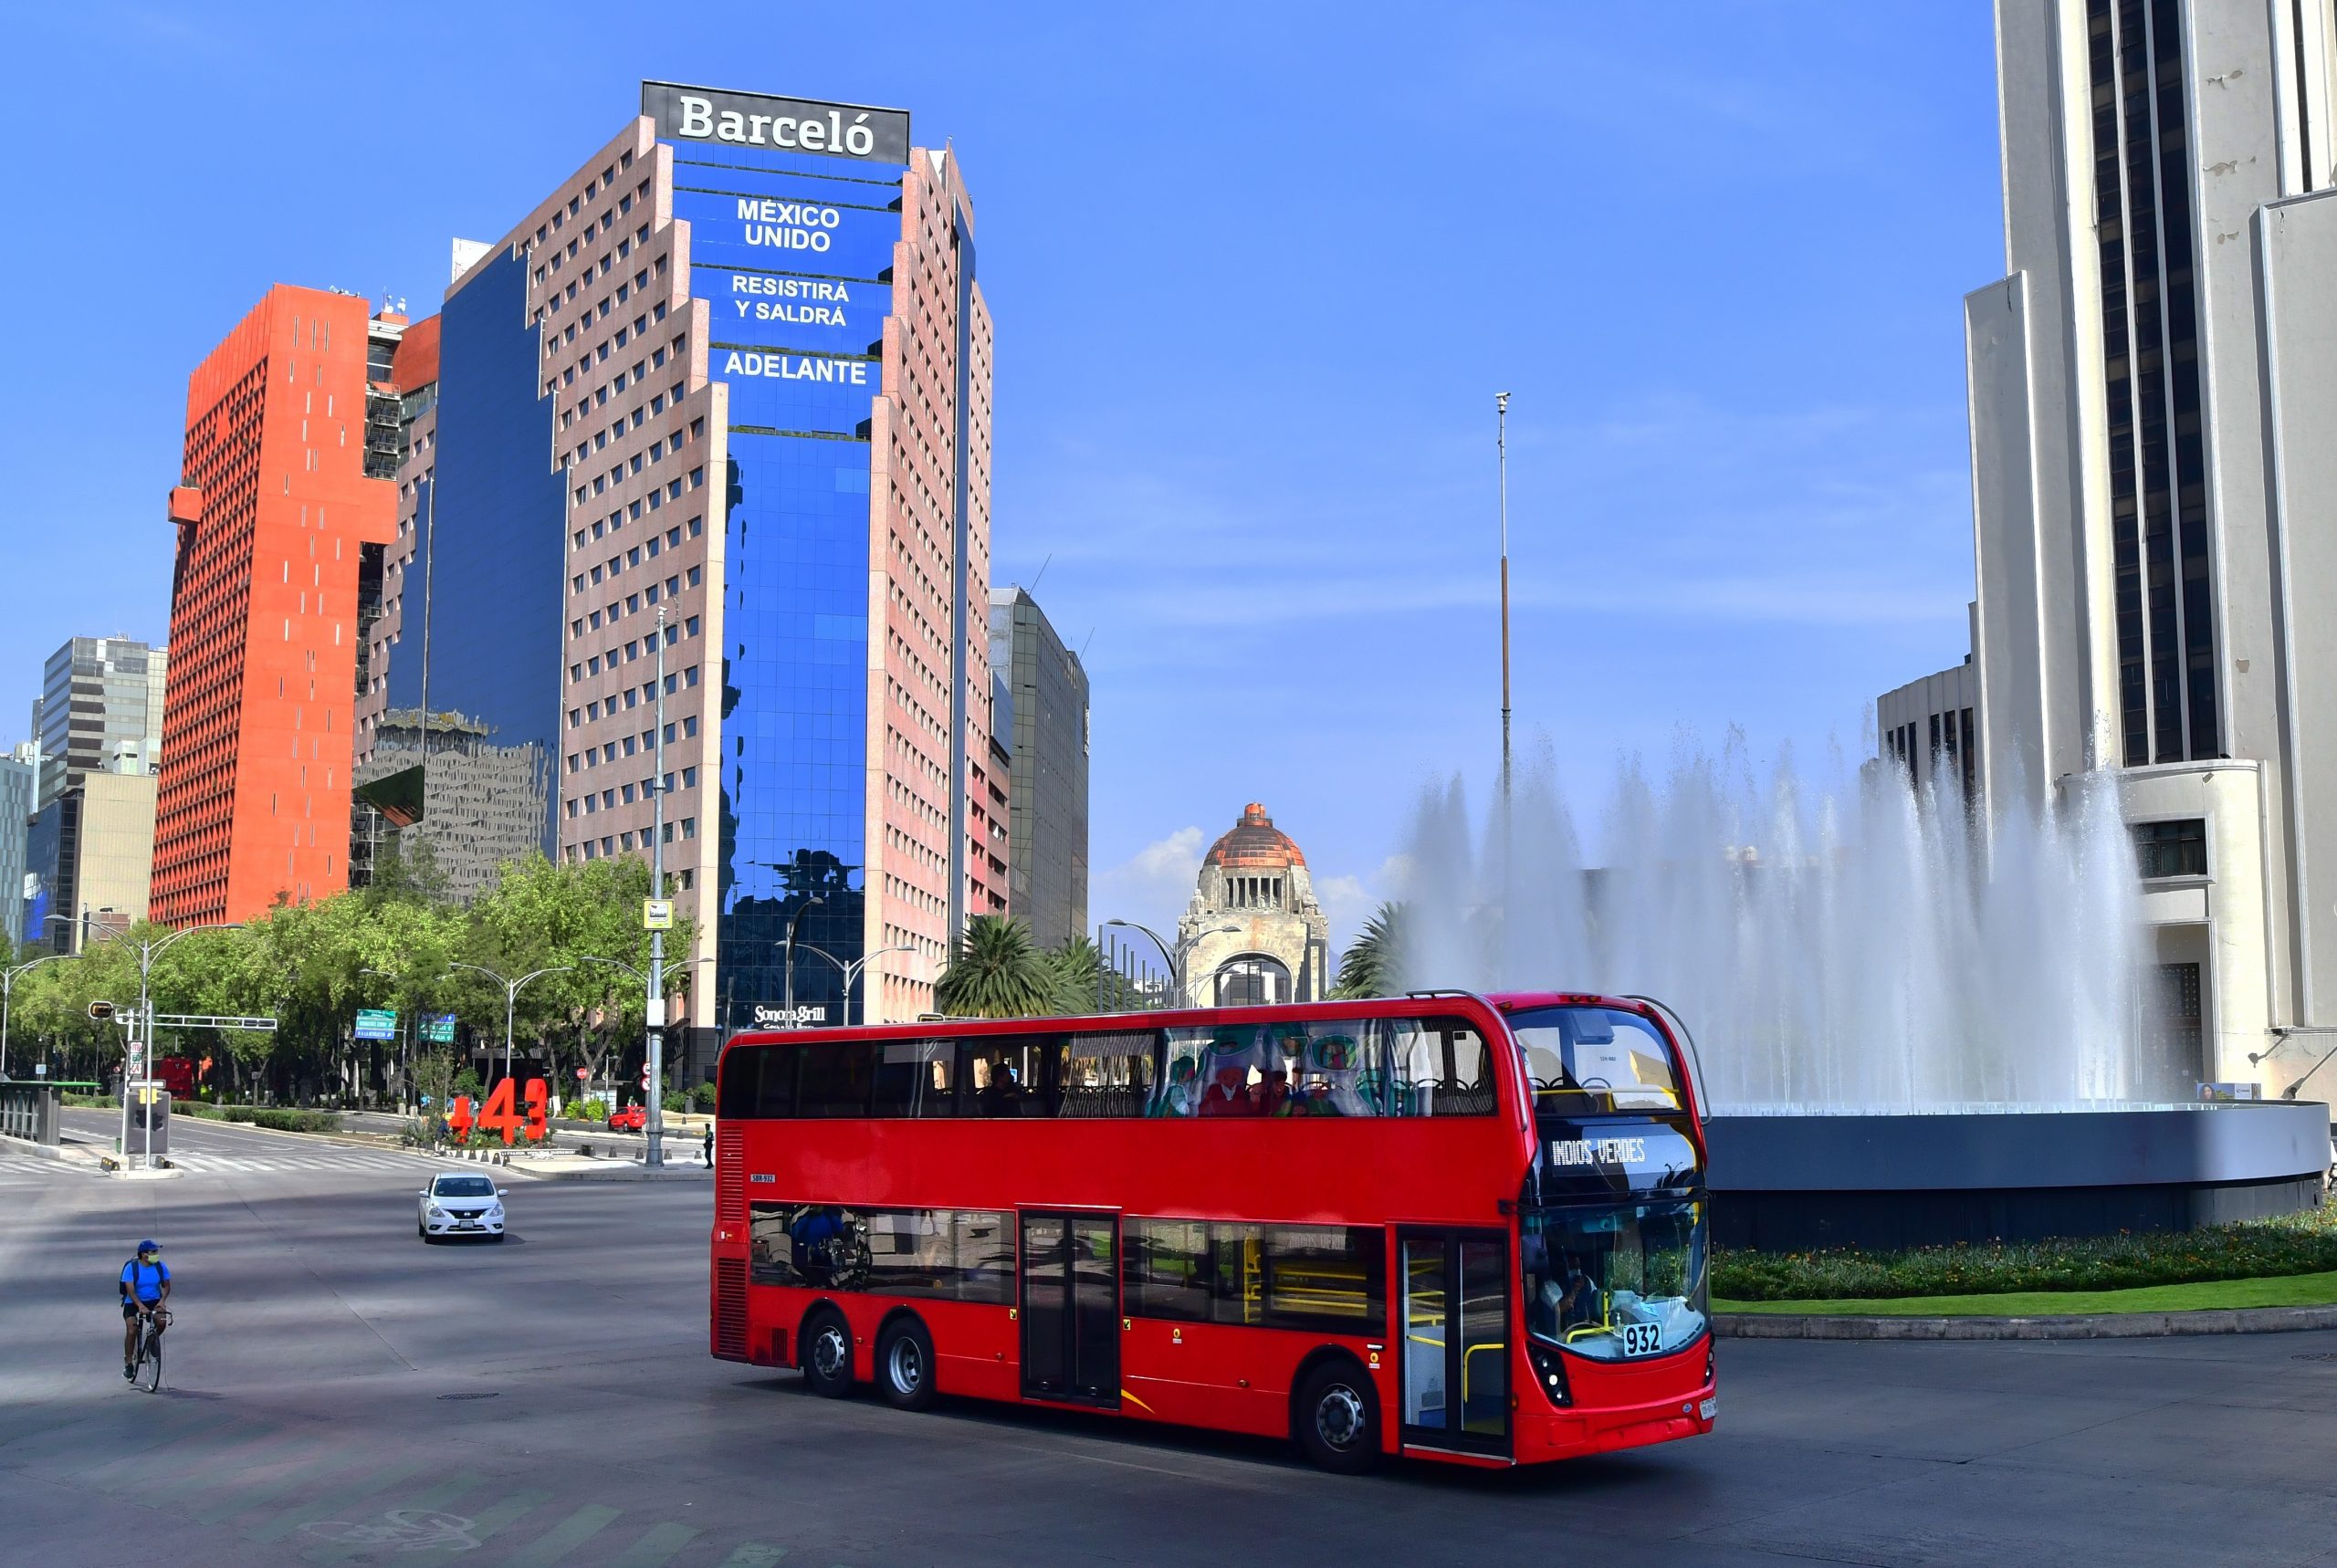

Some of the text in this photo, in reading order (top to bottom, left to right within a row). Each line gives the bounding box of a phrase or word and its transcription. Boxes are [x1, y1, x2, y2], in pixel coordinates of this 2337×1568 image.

[679, 96, 874, 156] Barceló
[738, 199, 840, 229] MÉXICO
[745, 225, 831, 252] UNIDO
[732, 276, 849, 302] RESISTIRÁ
[735, 300, 846, 327] Y SALDRÁ
[724, 352, 866, 384] ADELANTE
[1552, 1139, 1645, 1166] INDIOS VERDES
[1626, 1324, 1661, 1354] 932
